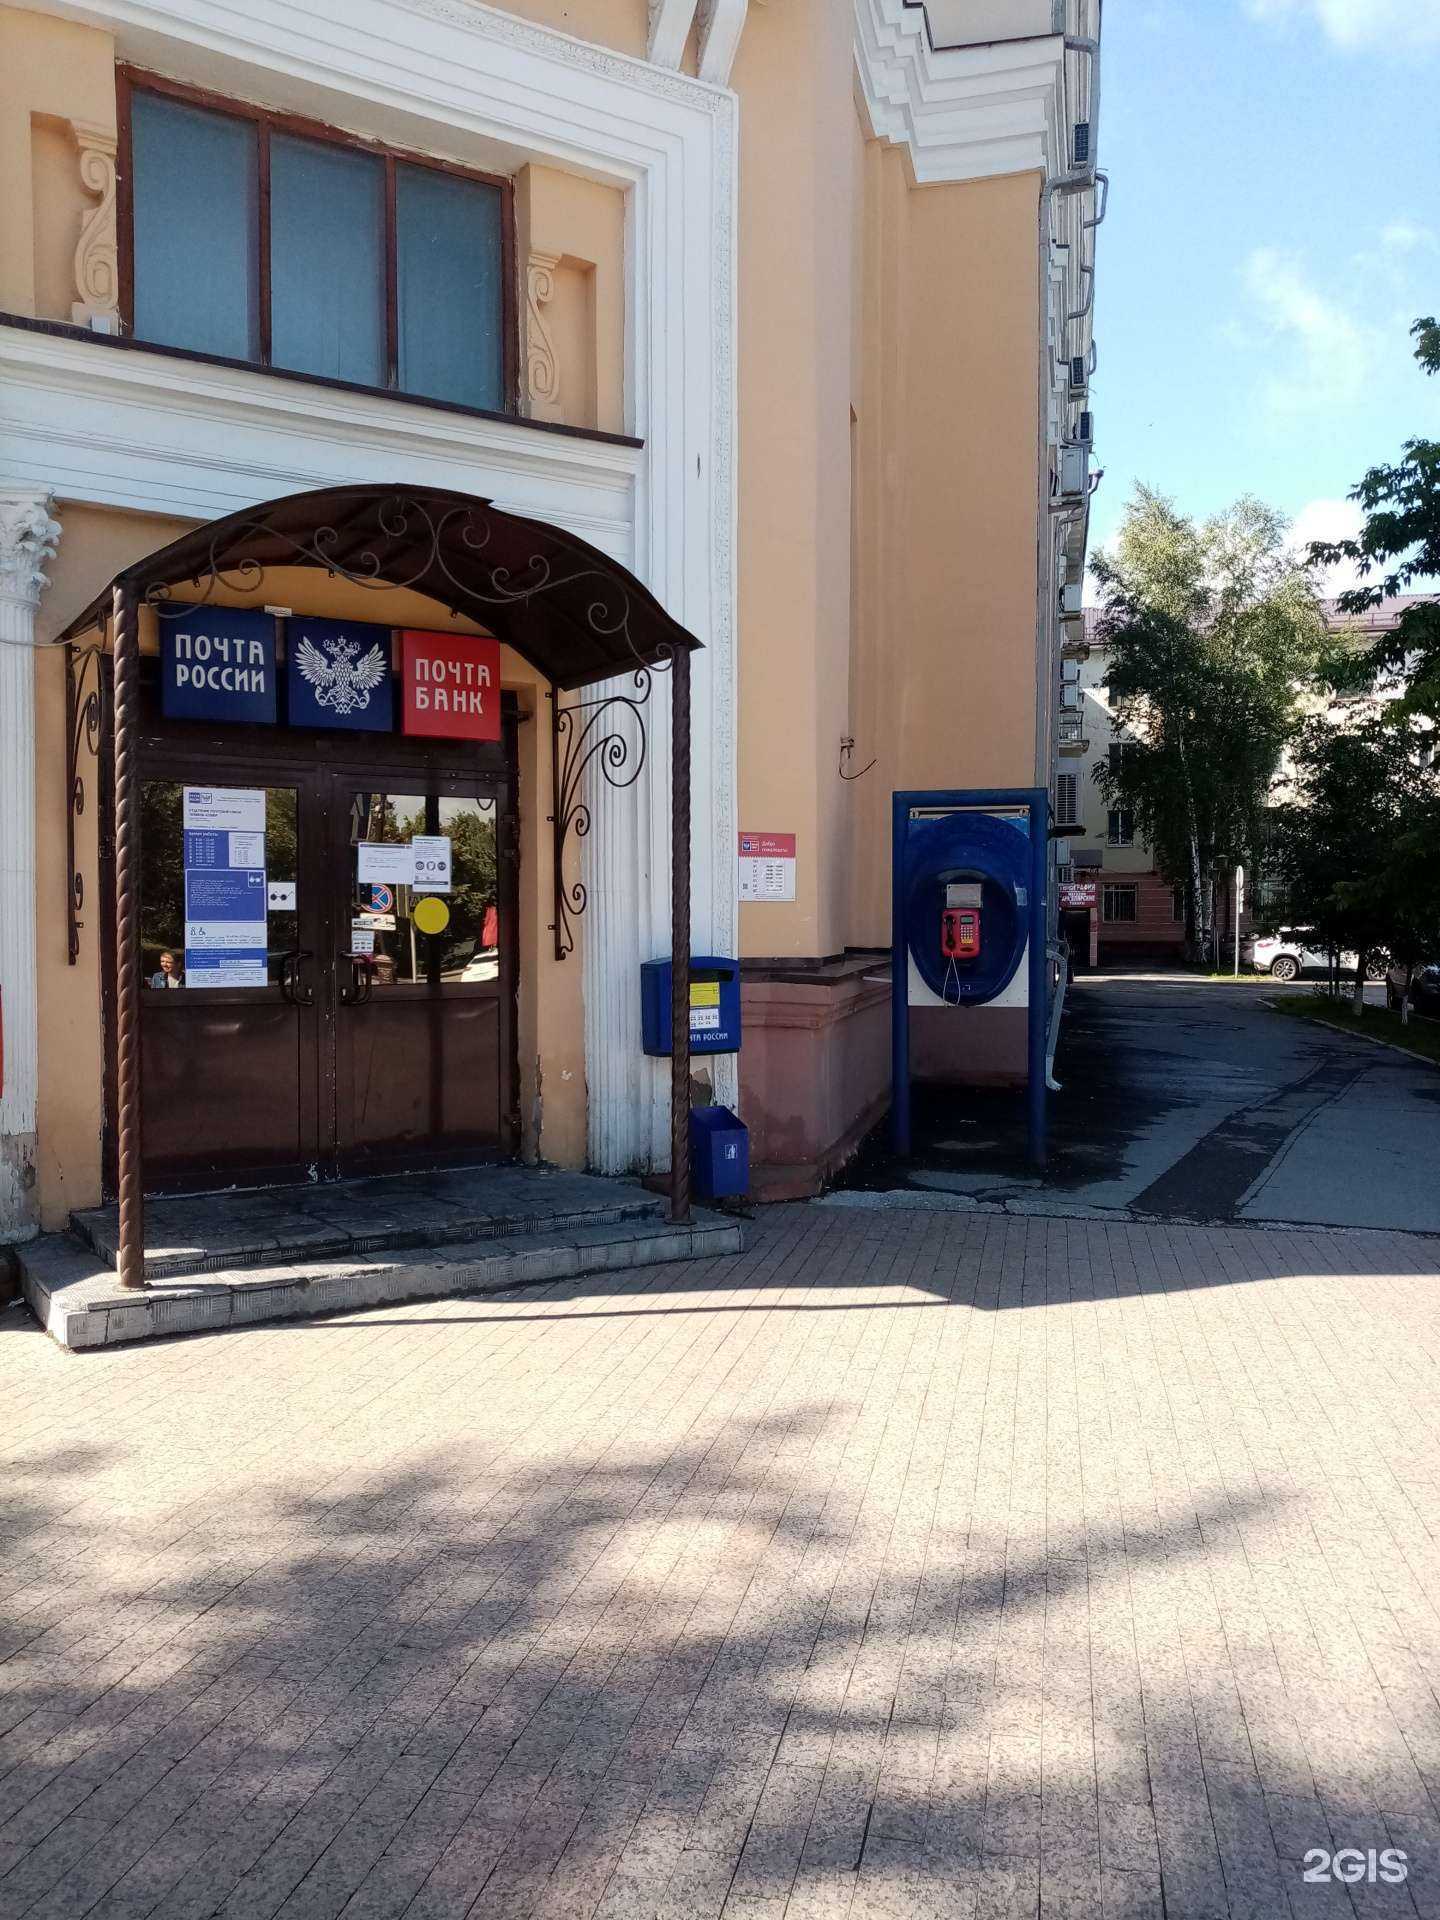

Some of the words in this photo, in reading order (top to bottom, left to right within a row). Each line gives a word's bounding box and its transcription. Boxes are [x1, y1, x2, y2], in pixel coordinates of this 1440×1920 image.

[175, 634, 265, 666] ПОЧТА
[176, 664, 265, 693] РОССИИ
[415, 658, 491, 688] ПОЧТА
[415, 686, 484, 714] БАНК
